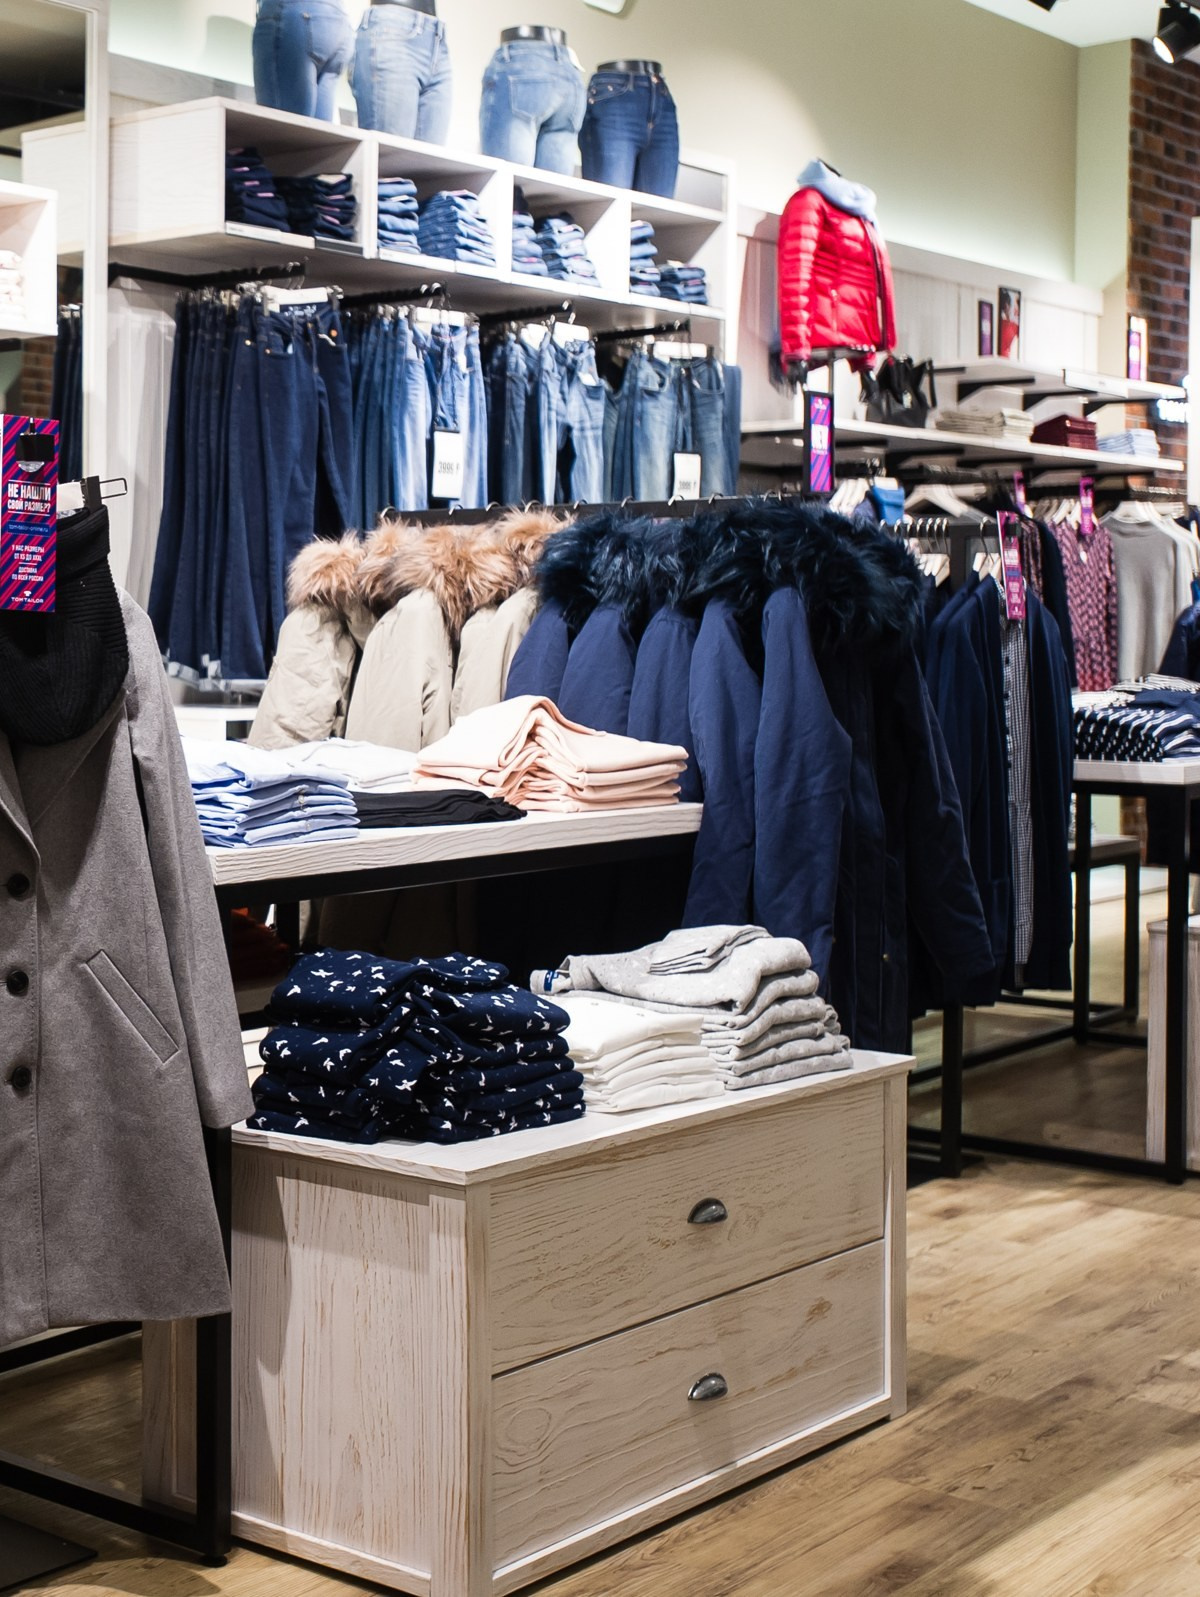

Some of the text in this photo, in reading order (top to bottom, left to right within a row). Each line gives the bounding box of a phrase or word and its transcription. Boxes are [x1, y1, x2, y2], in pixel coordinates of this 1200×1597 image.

[8, 483, 51, 501] НЕ НАШЛИ
[8, 498, 51, 513] СВОЙ РАЗМЕР?
